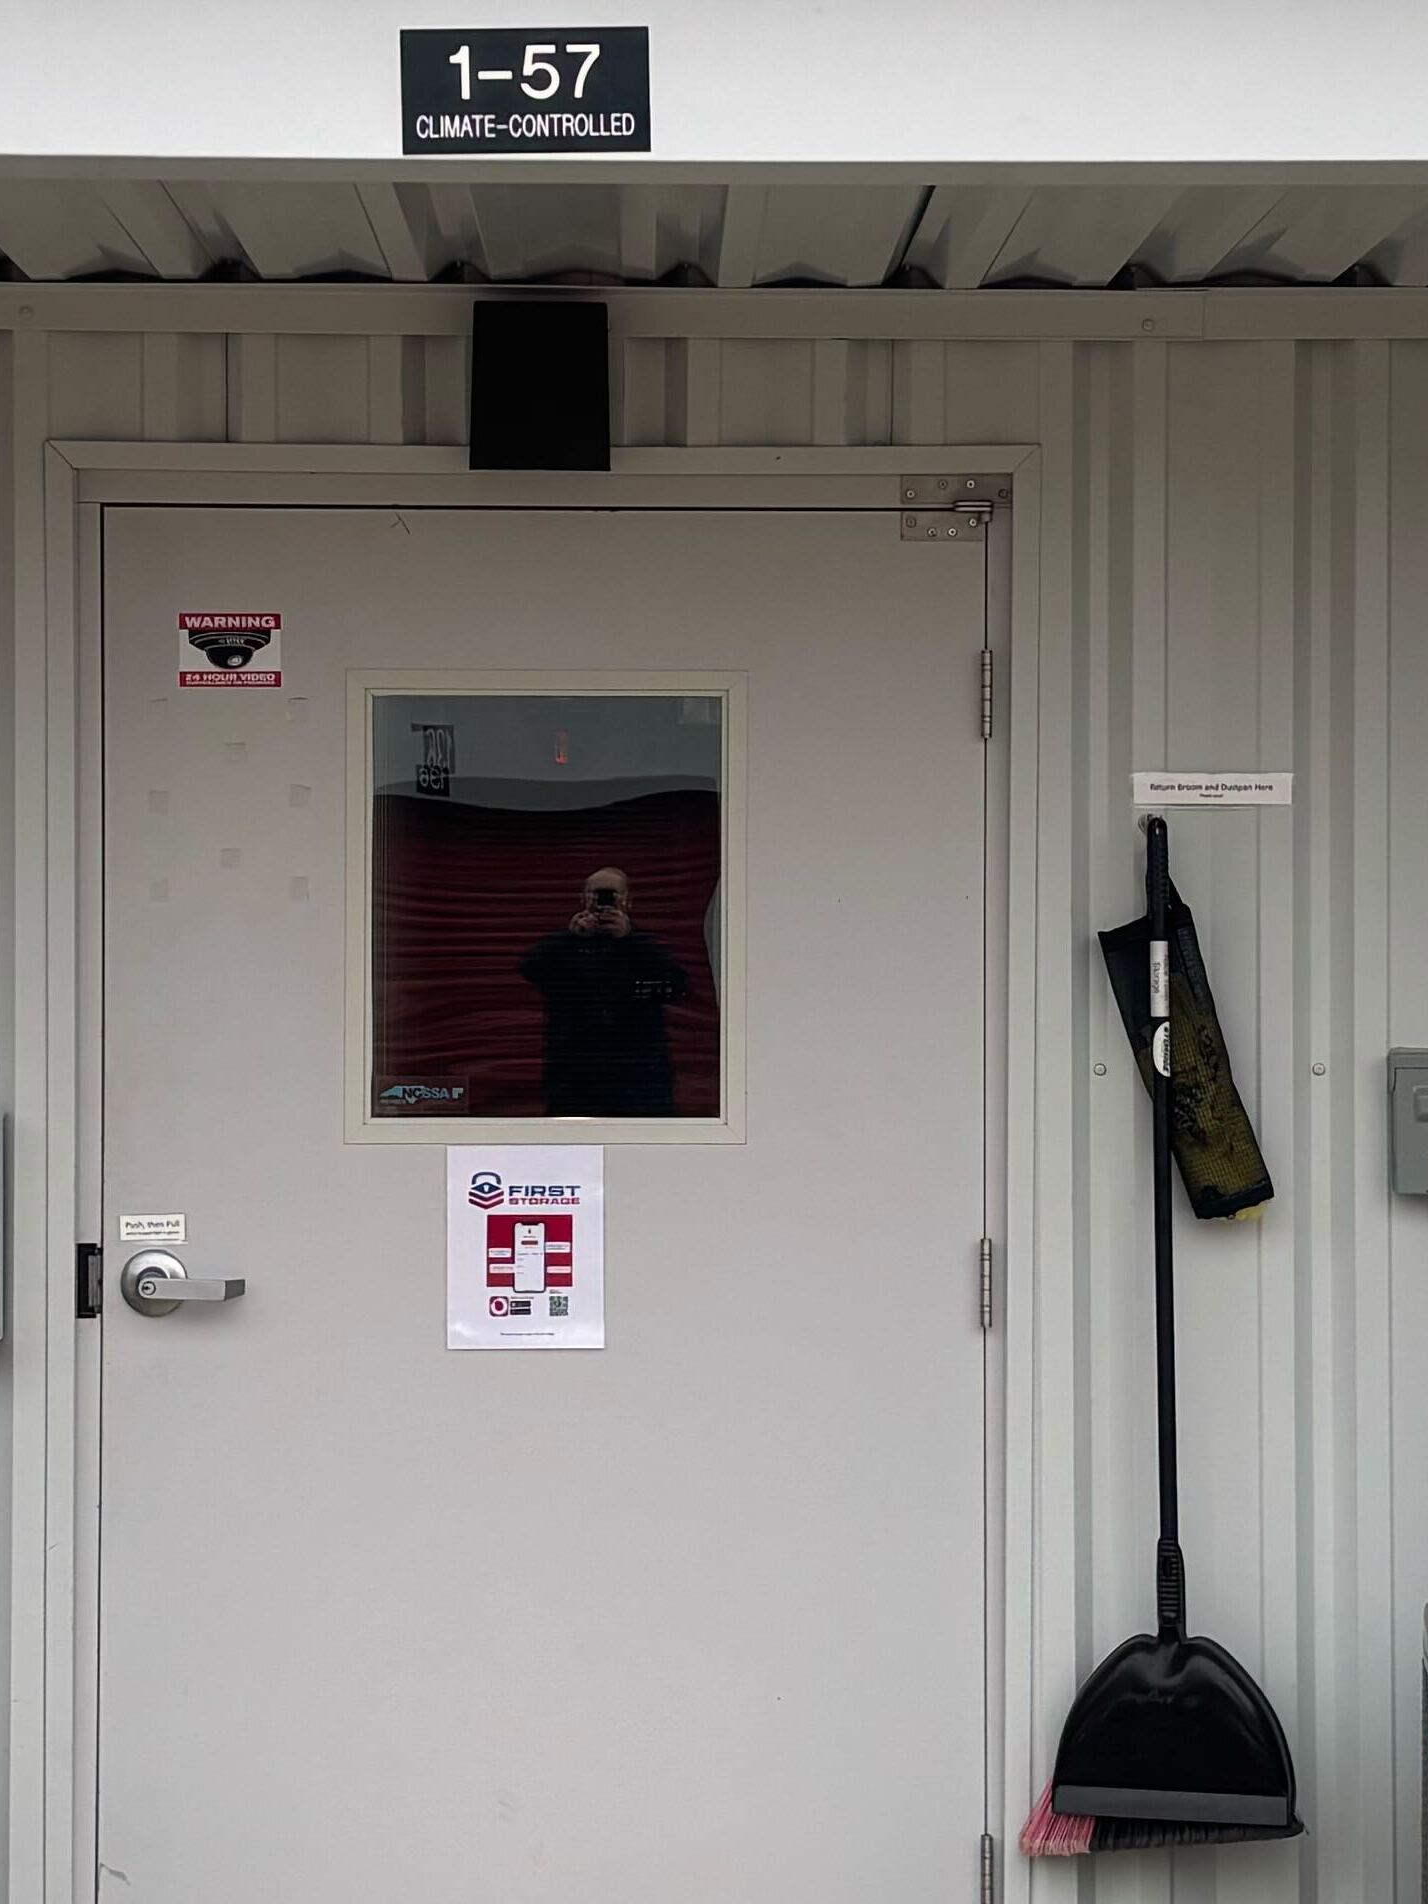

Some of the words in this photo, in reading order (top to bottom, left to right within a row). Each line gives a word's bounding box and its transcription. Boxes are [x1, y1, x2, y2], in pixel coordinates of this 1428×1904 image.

[449, 44, 600, 100] 1-57
[416, 113, 634, 138] CLIMATE-CONTROLLED
[185, 616, 275, 628] WARNING
[509, 1186, 580, 1196] FIRST
